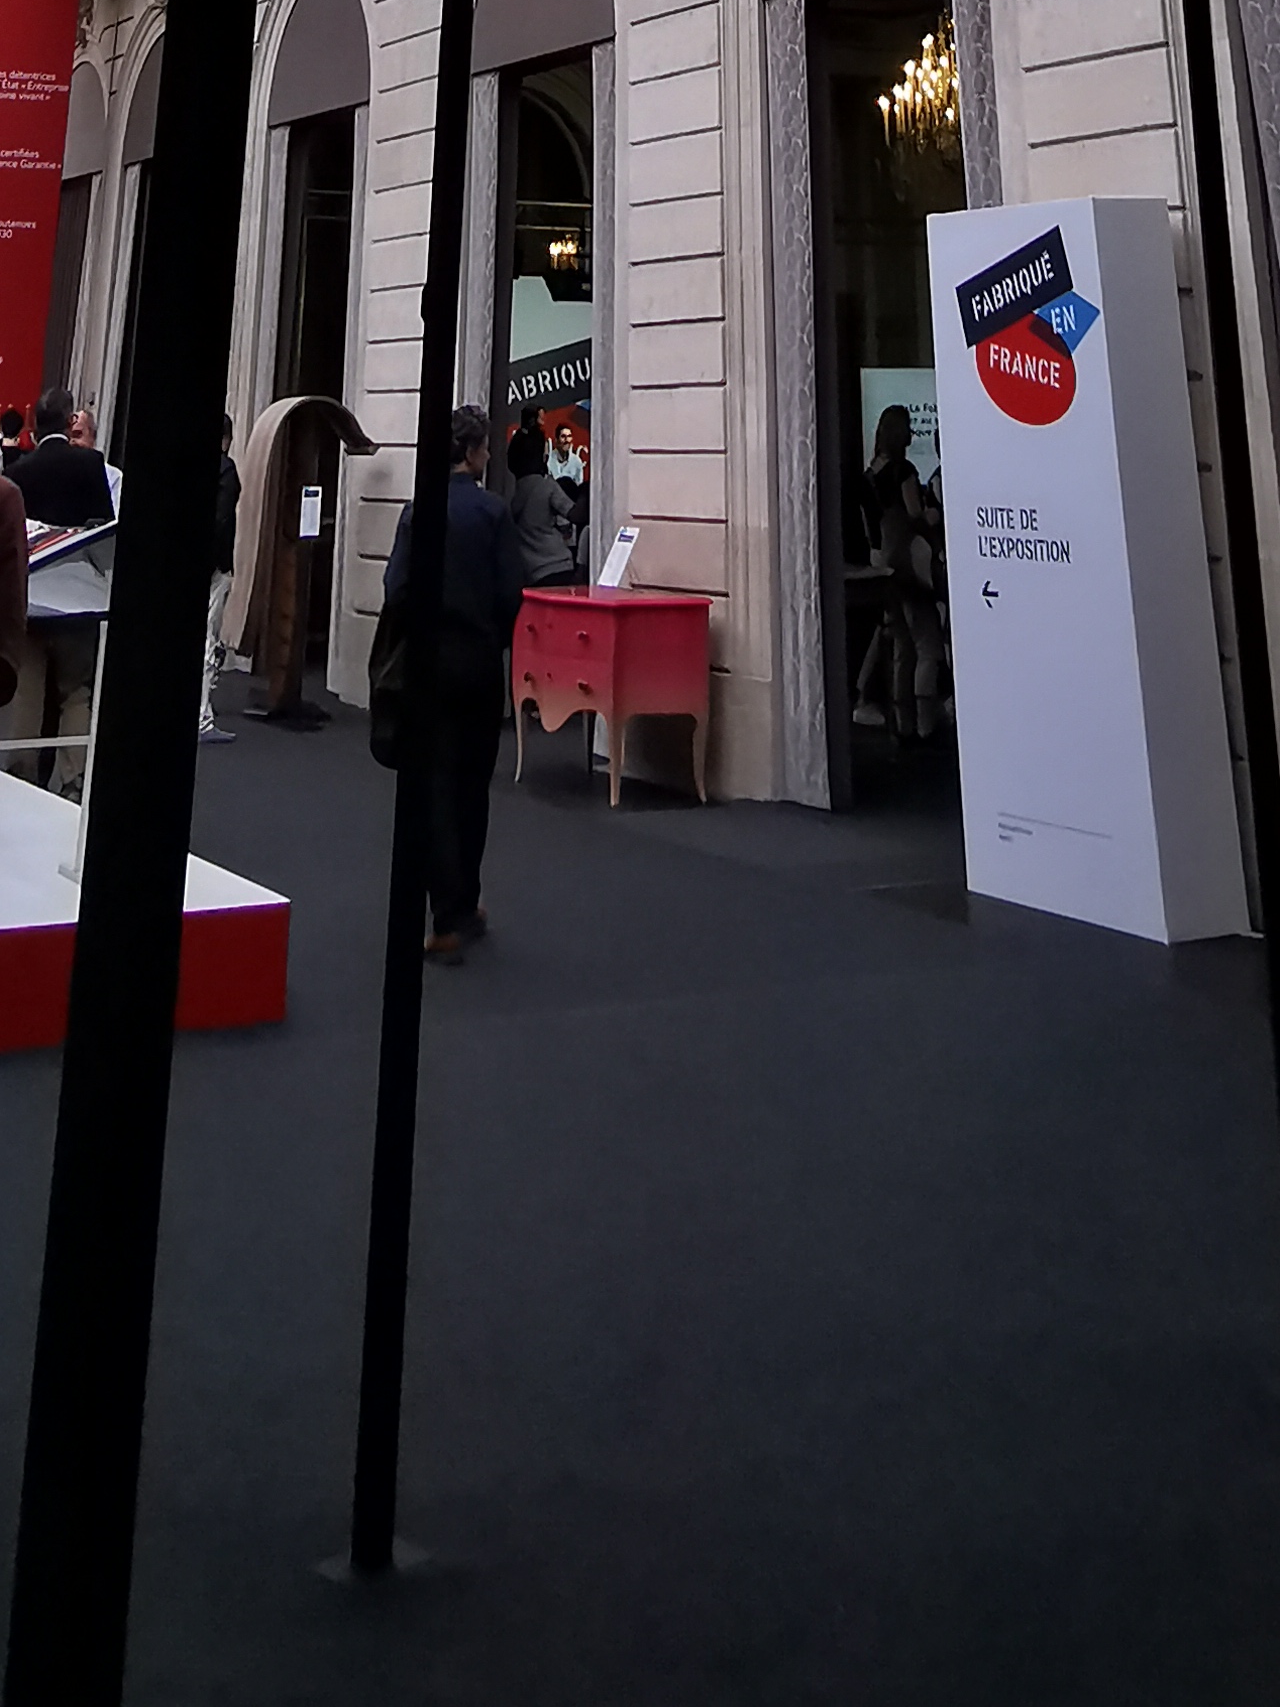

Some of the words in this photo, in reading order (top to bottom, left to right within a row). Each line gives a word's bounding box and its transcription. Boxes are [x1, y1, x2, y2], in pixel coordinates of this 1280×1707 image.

[972, 249, 1055, 322] FABRIQUÉ
[1050, 305, 1076, 335] EN
[508, 357, 591, 405] ABRIQU
[989, 342, 1061, 389] FRANCE
[976, 506, 1015, 530] SUITE
[1019, 509, 1038, 531] DE
[978, 535, 1071, 564] L'EXPOSITION
